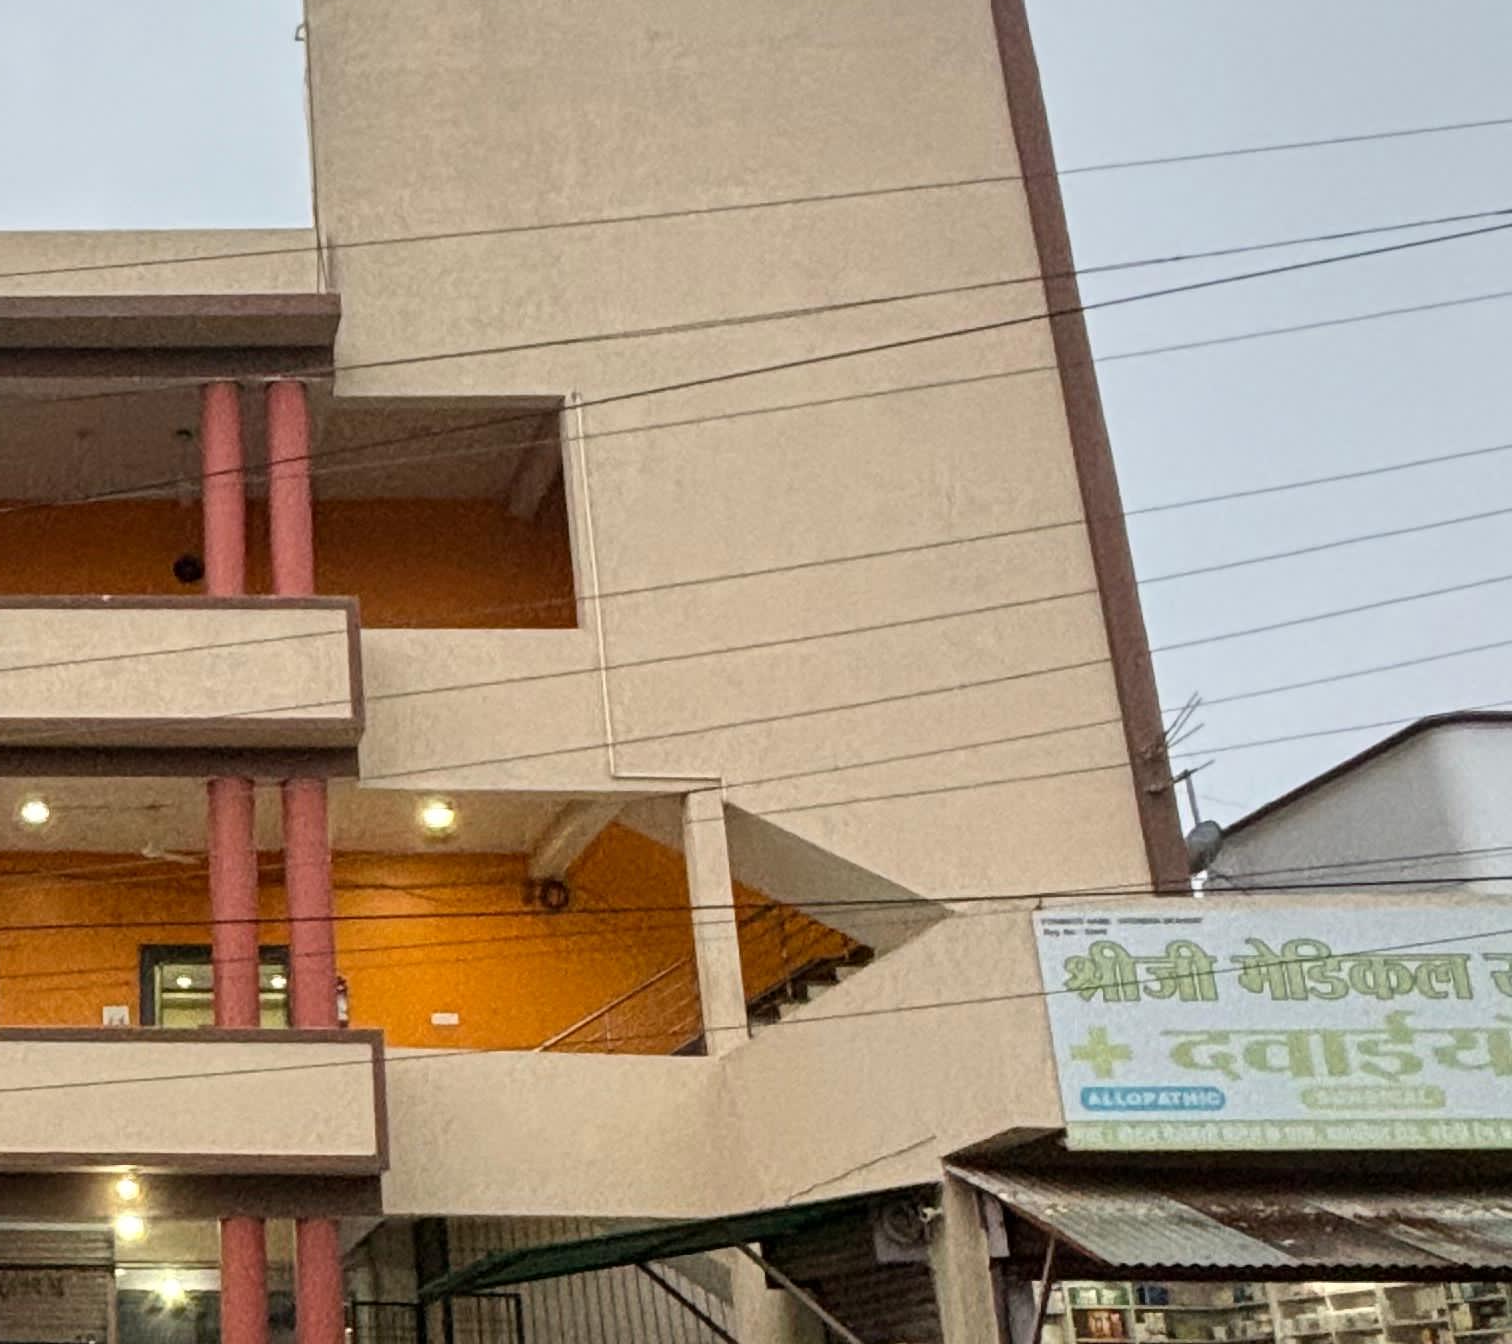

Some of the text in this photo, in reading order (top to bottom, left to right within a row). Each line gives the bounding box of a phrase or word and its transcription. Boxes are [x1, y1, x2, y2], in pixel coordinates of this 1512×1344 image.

[1064, 940, 1219, 1003] श्रीजी
[1230, 937, 1474, 1002] मेडिकल
[1159, 1010, 1512, 1083] दवाईय
[1088, 1090, 1222, 1106] ALLOPATHIC
